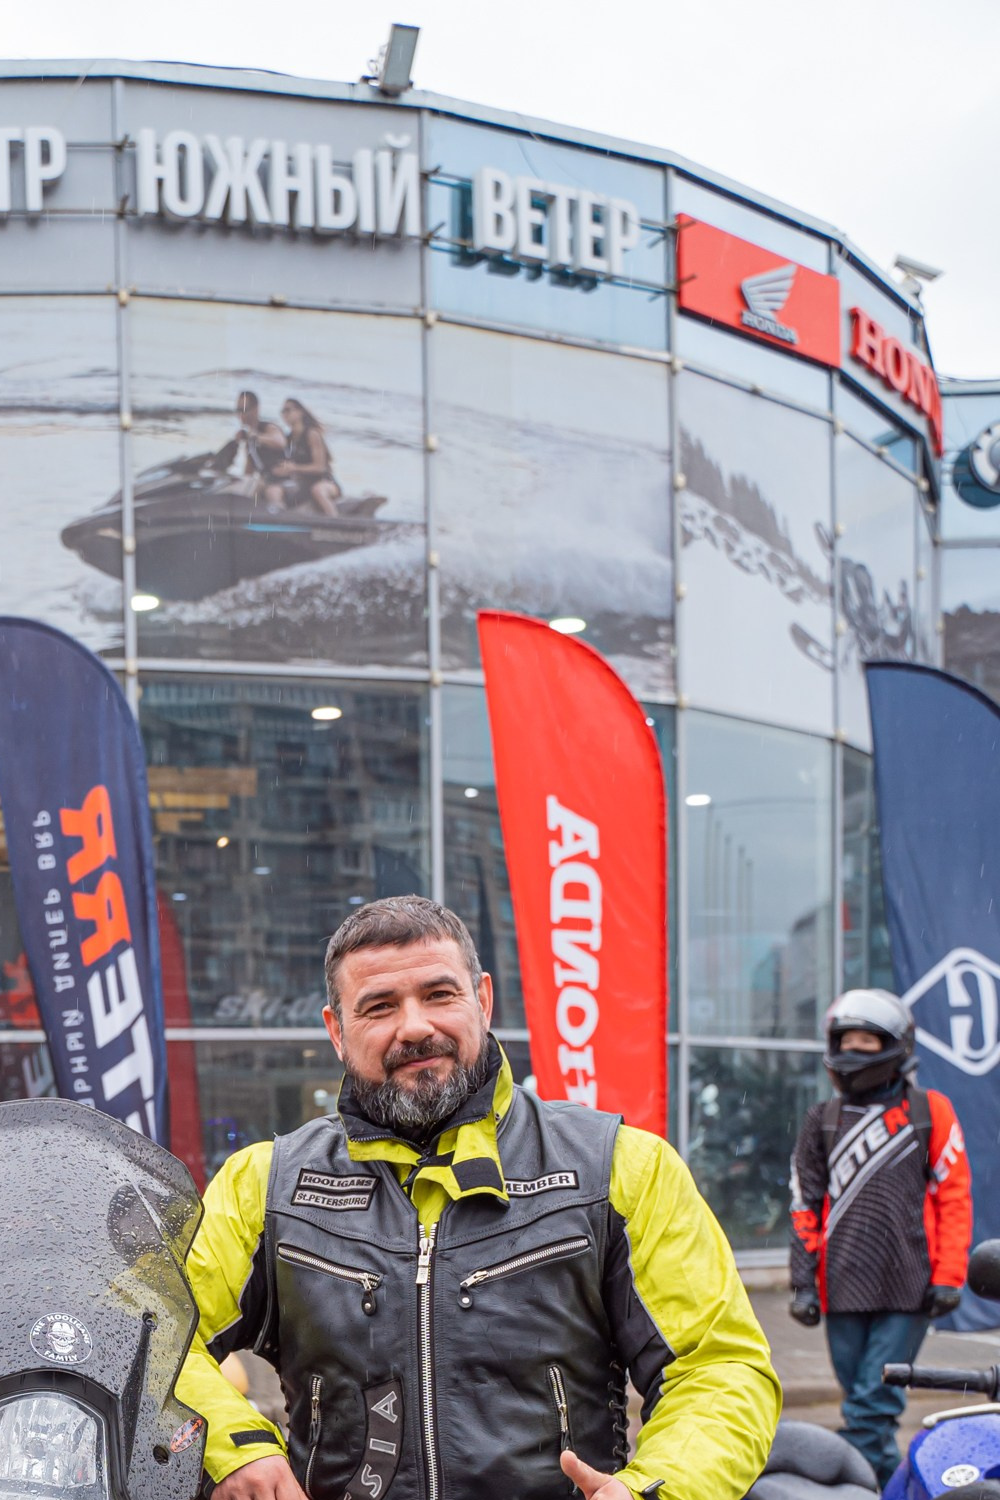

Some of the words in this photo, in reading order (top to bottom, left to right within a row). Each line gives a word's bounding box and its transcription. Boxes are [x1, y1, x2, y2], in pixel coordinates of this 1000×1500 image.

[139, 129, 422, 237] ЮЖНЫЙ
[472, 166, 640, 276] ВЕТЕР
[741, 310, 797, 345] HONDA
[849, 306, 943, 458] HON
[302, 1175, 373, 1188] HOOLIGANS
[32, 1320, 46, 1337] THE
[46, 1314, 90, 1345] HOOLIGANS
[44, 1350, 78, 1362] FAMILY
